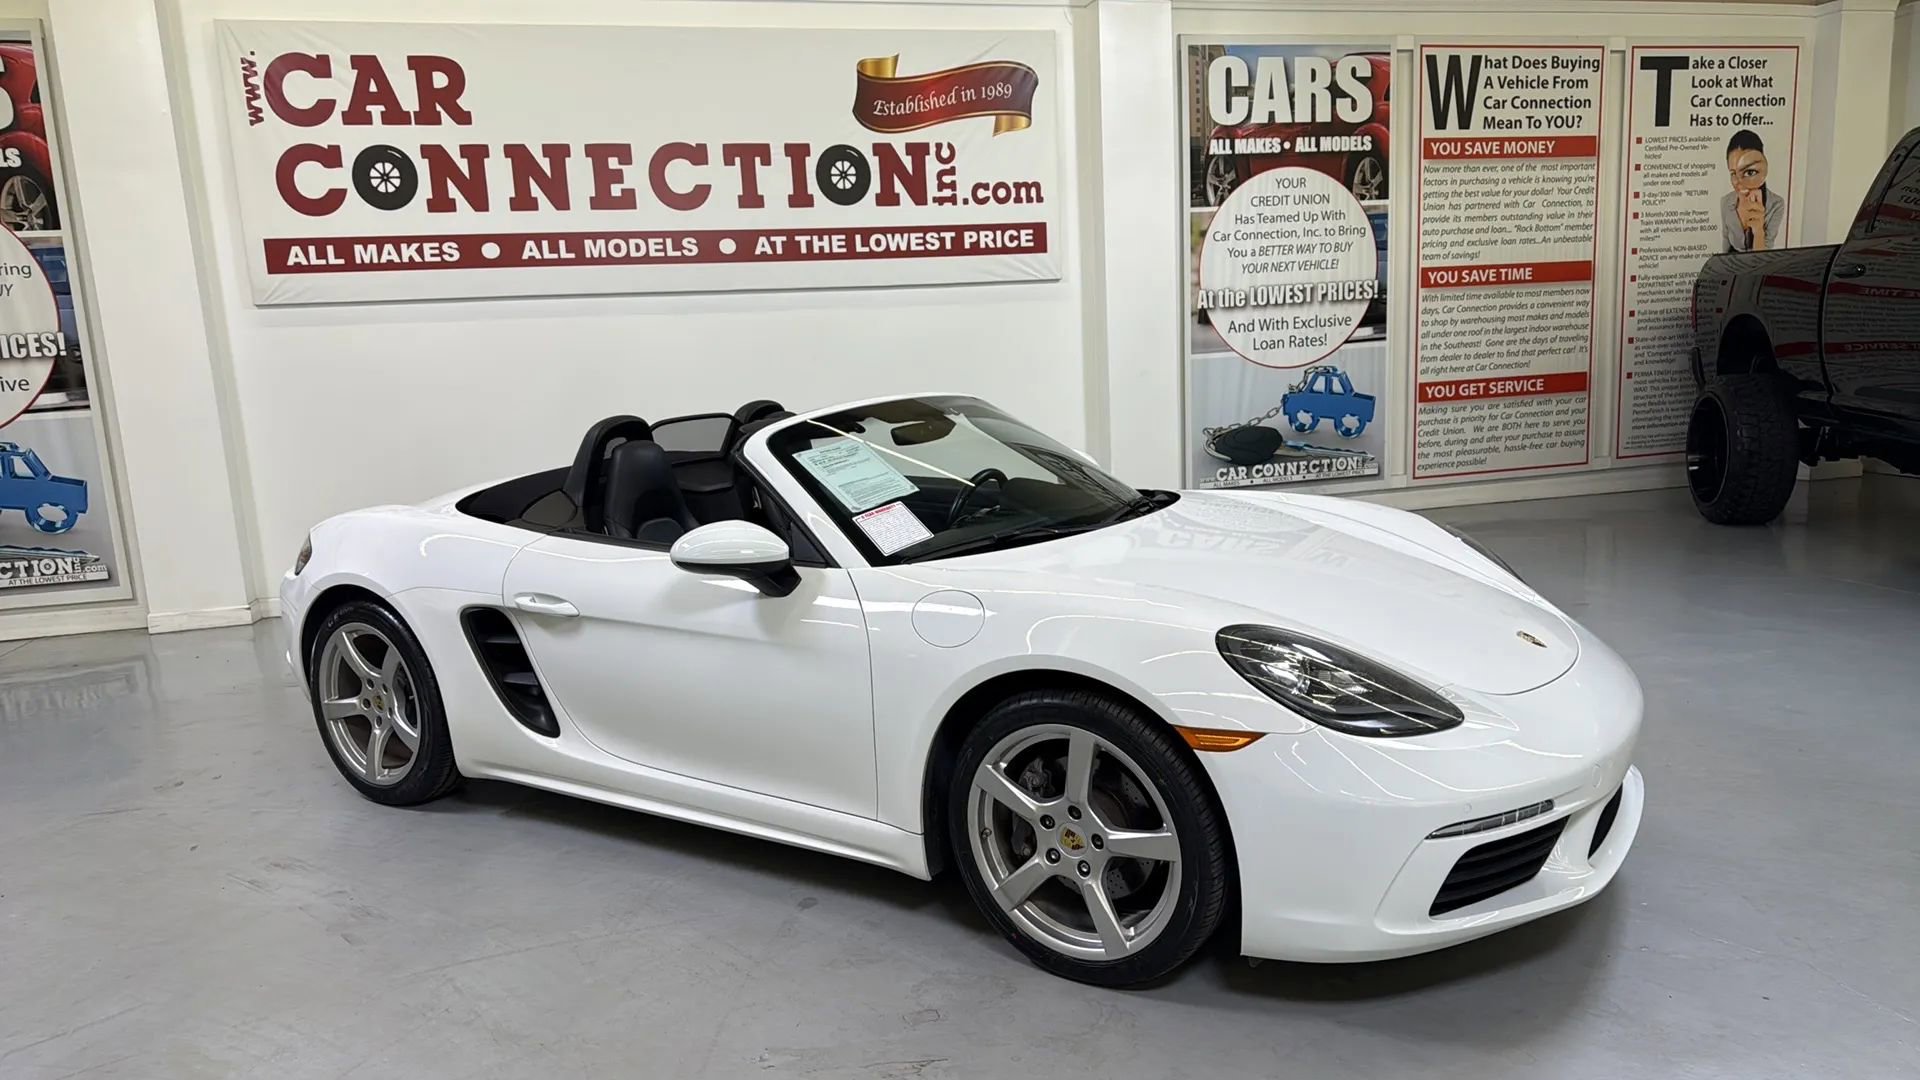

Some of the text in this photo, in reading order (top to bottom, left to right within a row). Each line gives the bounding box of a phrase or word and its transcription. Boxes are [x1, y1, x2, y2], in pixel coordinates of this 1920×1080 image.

[1512, 56, 1547, 69] Does
[1551, 56, 1600, 72] Buying
[1718, 59, 1724, 69] a
[1728, 56, 1767, 69] Closer
[240, 50, 265, 127] www.
[263, 51, 472, 127] CAR
[1484, 75, 1588, 89] A Vehicle From
[1692, 75, 1773, 88] Look at What
[1208, 56, 1373, 126] CARS
[873, 83, 1012, 117] Established in 1989
[1483, 96, 1591, 109] Car Connection
[1691, 94, 1786, 107] Car Connection
[1483, 115, 1582, 129] Mean To YOU?
[1690, 113, 1773, 126] Has to Offer...
[1209, 136, 1372, 155] ALL MAKES ALL MODELS
[1431, 141, 1555, 155] YOU SAVE MONEY
[1424, 165, 1440, 173] Now
[1464, 164, 1480, 172] than
[1560, 163, 1595, 172] important
[275, 141, 930, 217] CONNECTION
[1275, 178, 1306, 189] YOUR
[1423, 178, 1448, 186] factors
[1459, 177, 1499, 186] purchasing
[1508, 176, 1533, 184] vehicle
[1542, 175, 1572, 185] knowing
[1575, 175, 1594, 184] you're
[1251, 194, 1330, 207] CREDIT UNION
[1235, 210, 1346, 224] Has Teamed Up With
[1213, 226, 1366, 241] Car Connection, Inc. to Bring
[286, 229, 1034, 266] ALL MAKES ALL MODELS AT THE LOWEST PRICE
[1227, 248, 1247, 258] You
[1259, 245, 1293, 256] BETTER
[1296, 244, 1316, 255] WAY
[1320, 243, 1332, 253] TO
[1334, 242, 1353, 252] BUY
[1242, 259, 1339, 274] YOUR NEXT VEHICLE!
[1428, 268, 1533, 284] YOU SAVE TIME
[1197, 280, 1379, 309] At the LOWEST PRICES!
[1422, 294, 1438, 302] With
[1440, 293, 1465, 301] limited
[1466, 292, 1481, 300] time
[1483, 291, 1515, 300] available
[1525, 290, 1542, 298] most
[1543, 289, 1574, 297] members
[1228, 315, 1352, 334] And With Exclusive
[1253, 334, 1327, 350] Loan Rates!
[1420, 367, 1429, 375] all
[1431, 366, 1448, 376] right
[1450, 365, 1464, 373] here
[1475, 364, 1487, 372] Car
[1489, 361, 1531, 371] Connection!
[1426, 379, 1544, 398] YOU GET SERVICE
[1418, 407, 1447, 416] Making
[1470, 404, 1484, 413] you
[1504, 400, 1533, 409] satisfied
[1537, 398, 1552, 406] with
[1556, 398, 1571, 406] your
[1216, 466, 1247, 481] CAR
[1252, 456, 1358, 477] CONNECTION
